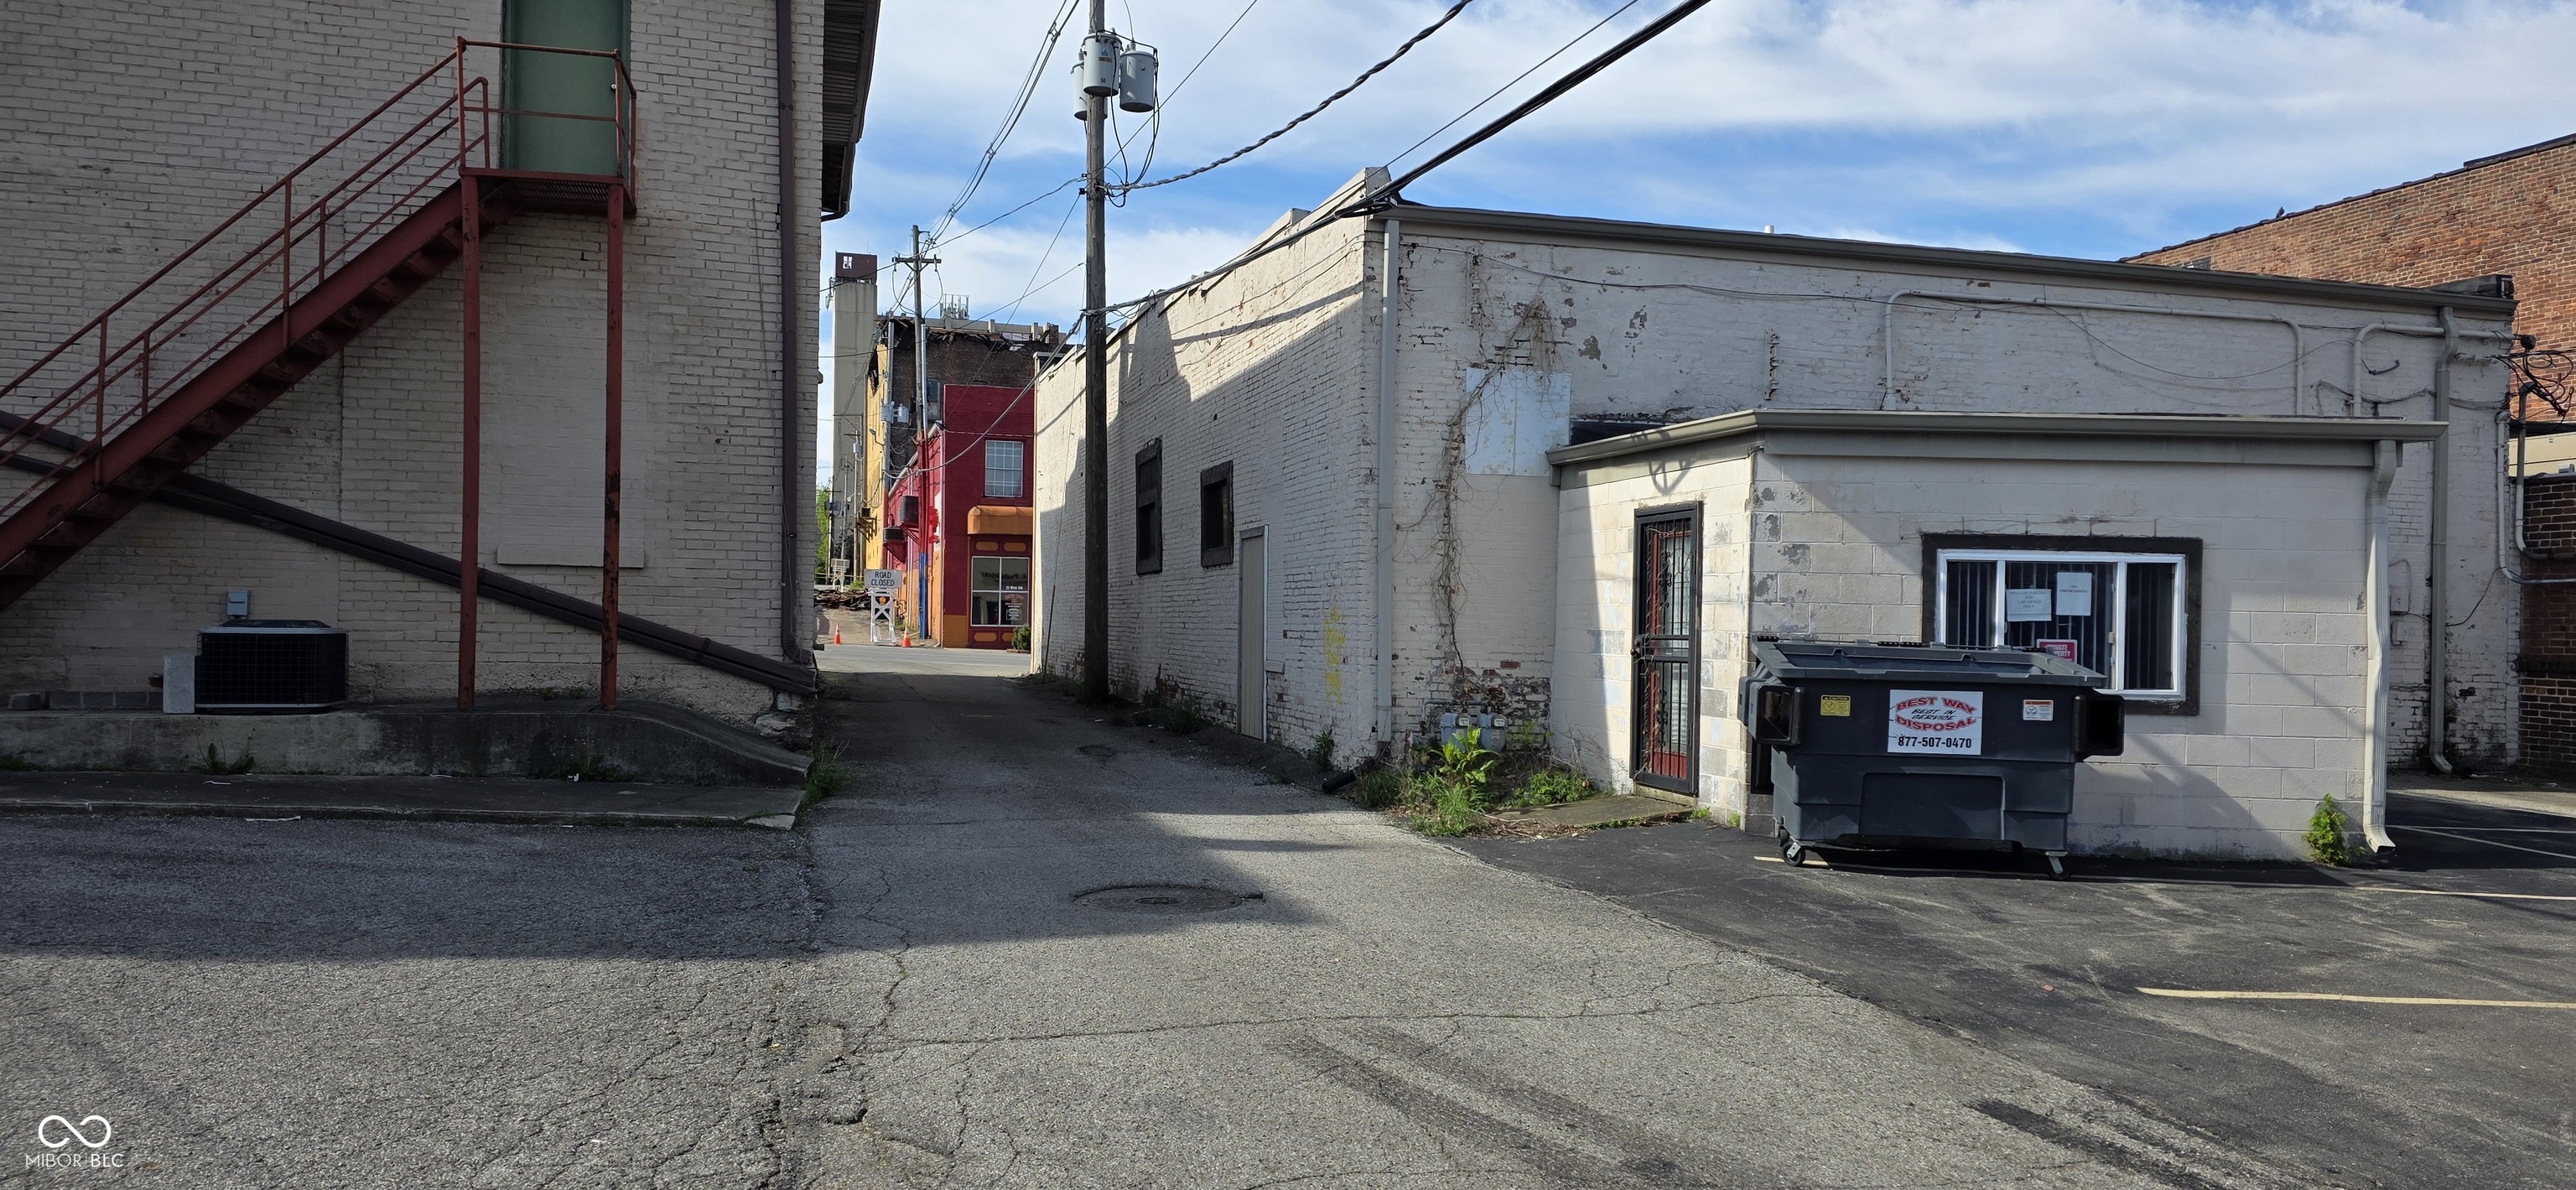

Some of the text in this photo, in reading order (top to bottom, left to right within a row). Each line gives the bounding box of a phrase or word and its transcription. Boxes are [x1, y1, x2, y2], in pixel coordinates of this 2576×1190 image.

[870, 579, 895, 587] CLOSED
[1896, 697, 1977, 715] BEST WAY
[1895, 715, 1976, 732] DISPOSAL
[1898, 736, 1972, 748] 877-507-0470
